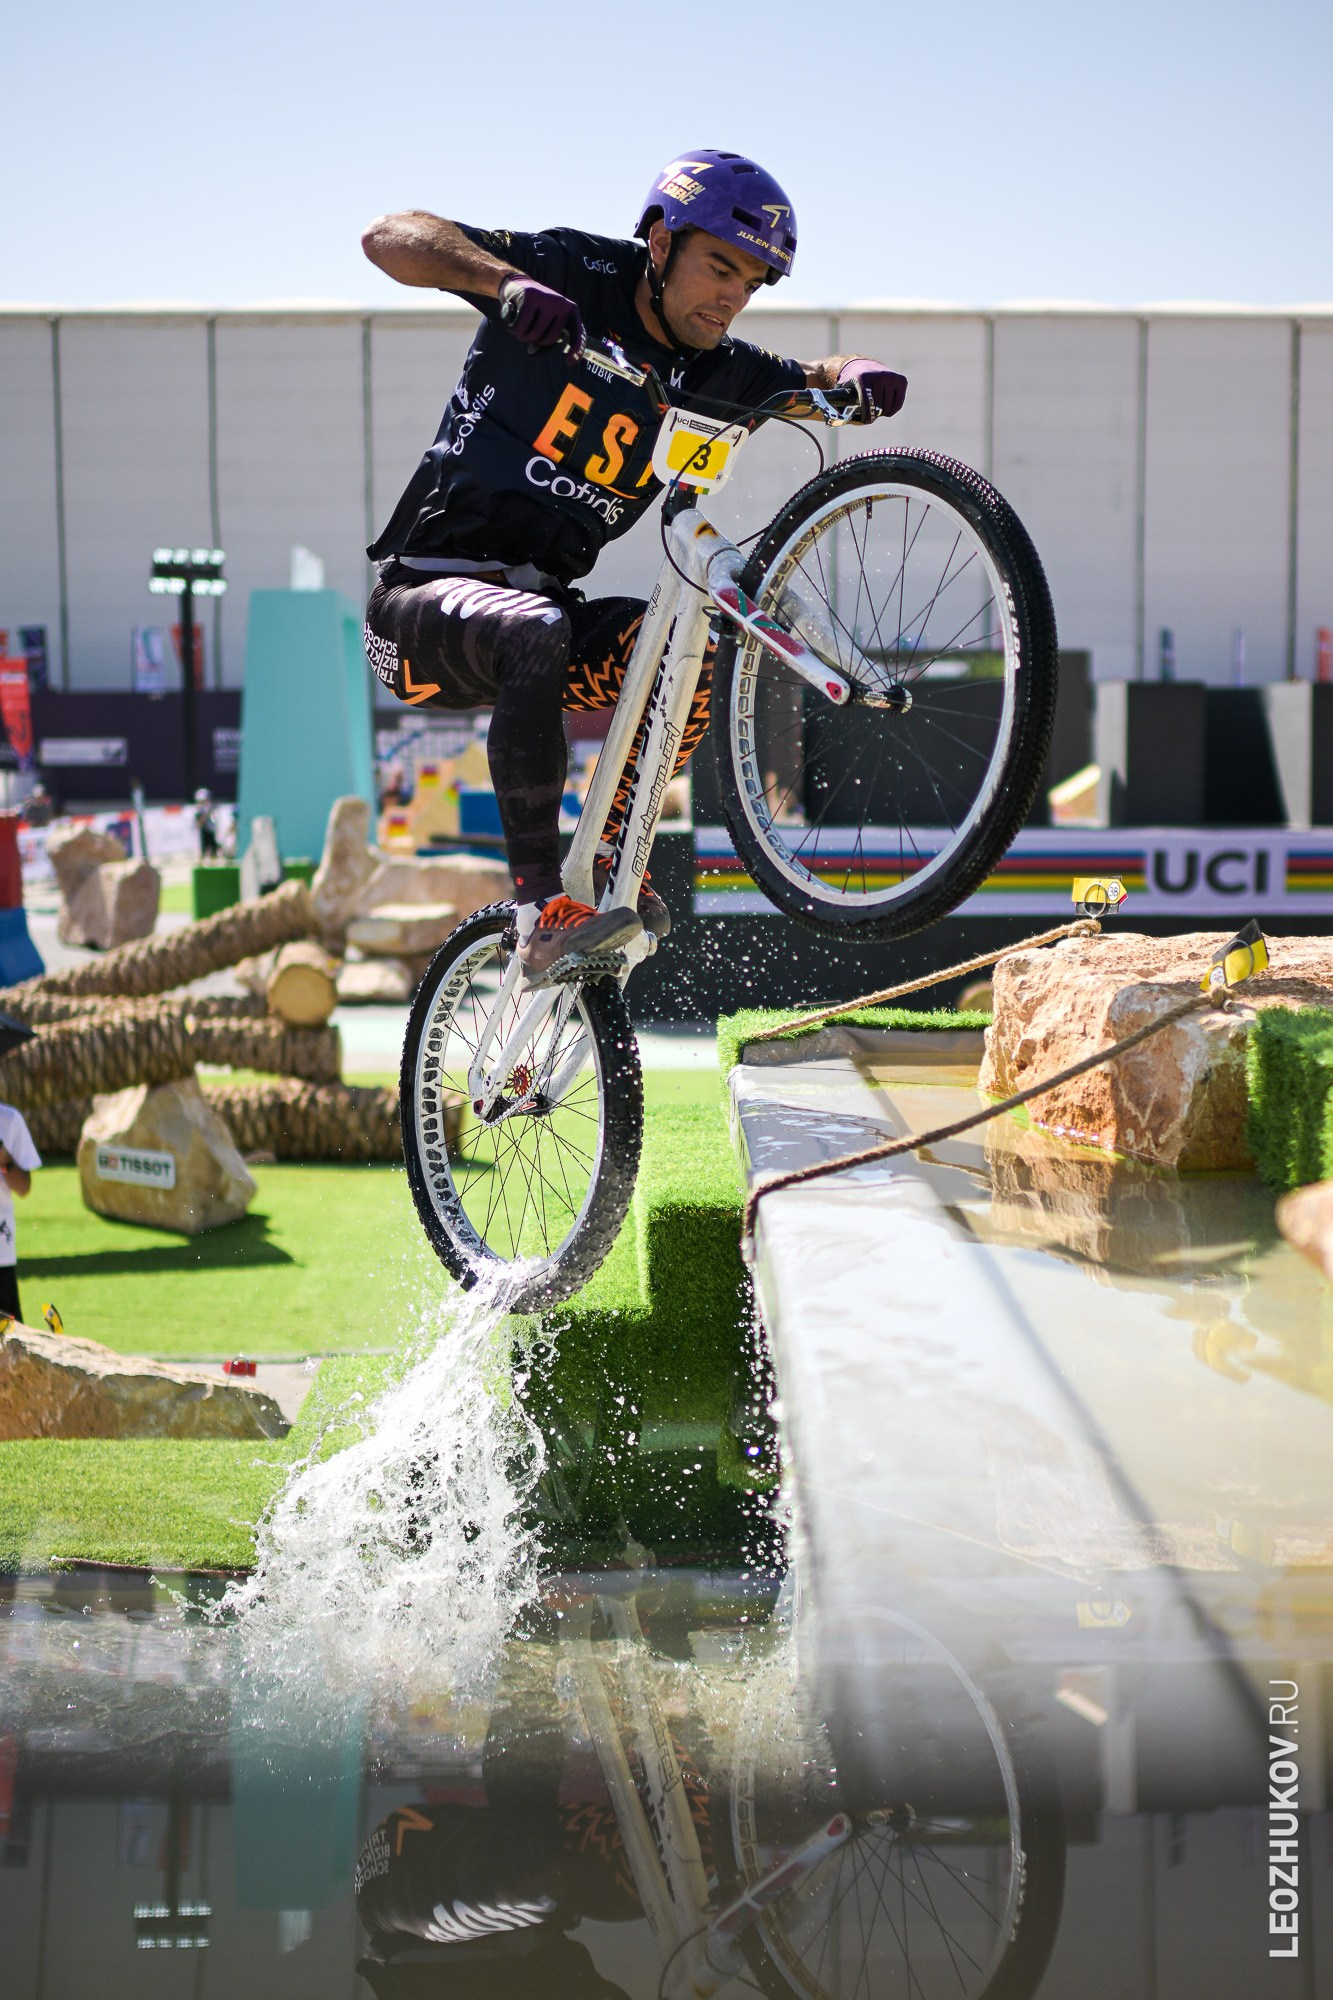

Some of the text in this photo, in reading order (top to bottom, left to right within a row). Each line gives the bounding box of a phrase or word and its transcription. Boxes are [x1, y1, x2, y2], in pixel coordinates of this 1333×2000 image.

[736, 230, 769, 249] JULEN
[677, 417, 690, 426] UCI
[692, 443, 712, 471] 3
[525, 456, 625, 525] Cofidis
[1153, 849, 1270, 896] UCI
[120, 1153, 171, 1178] TISSOT
